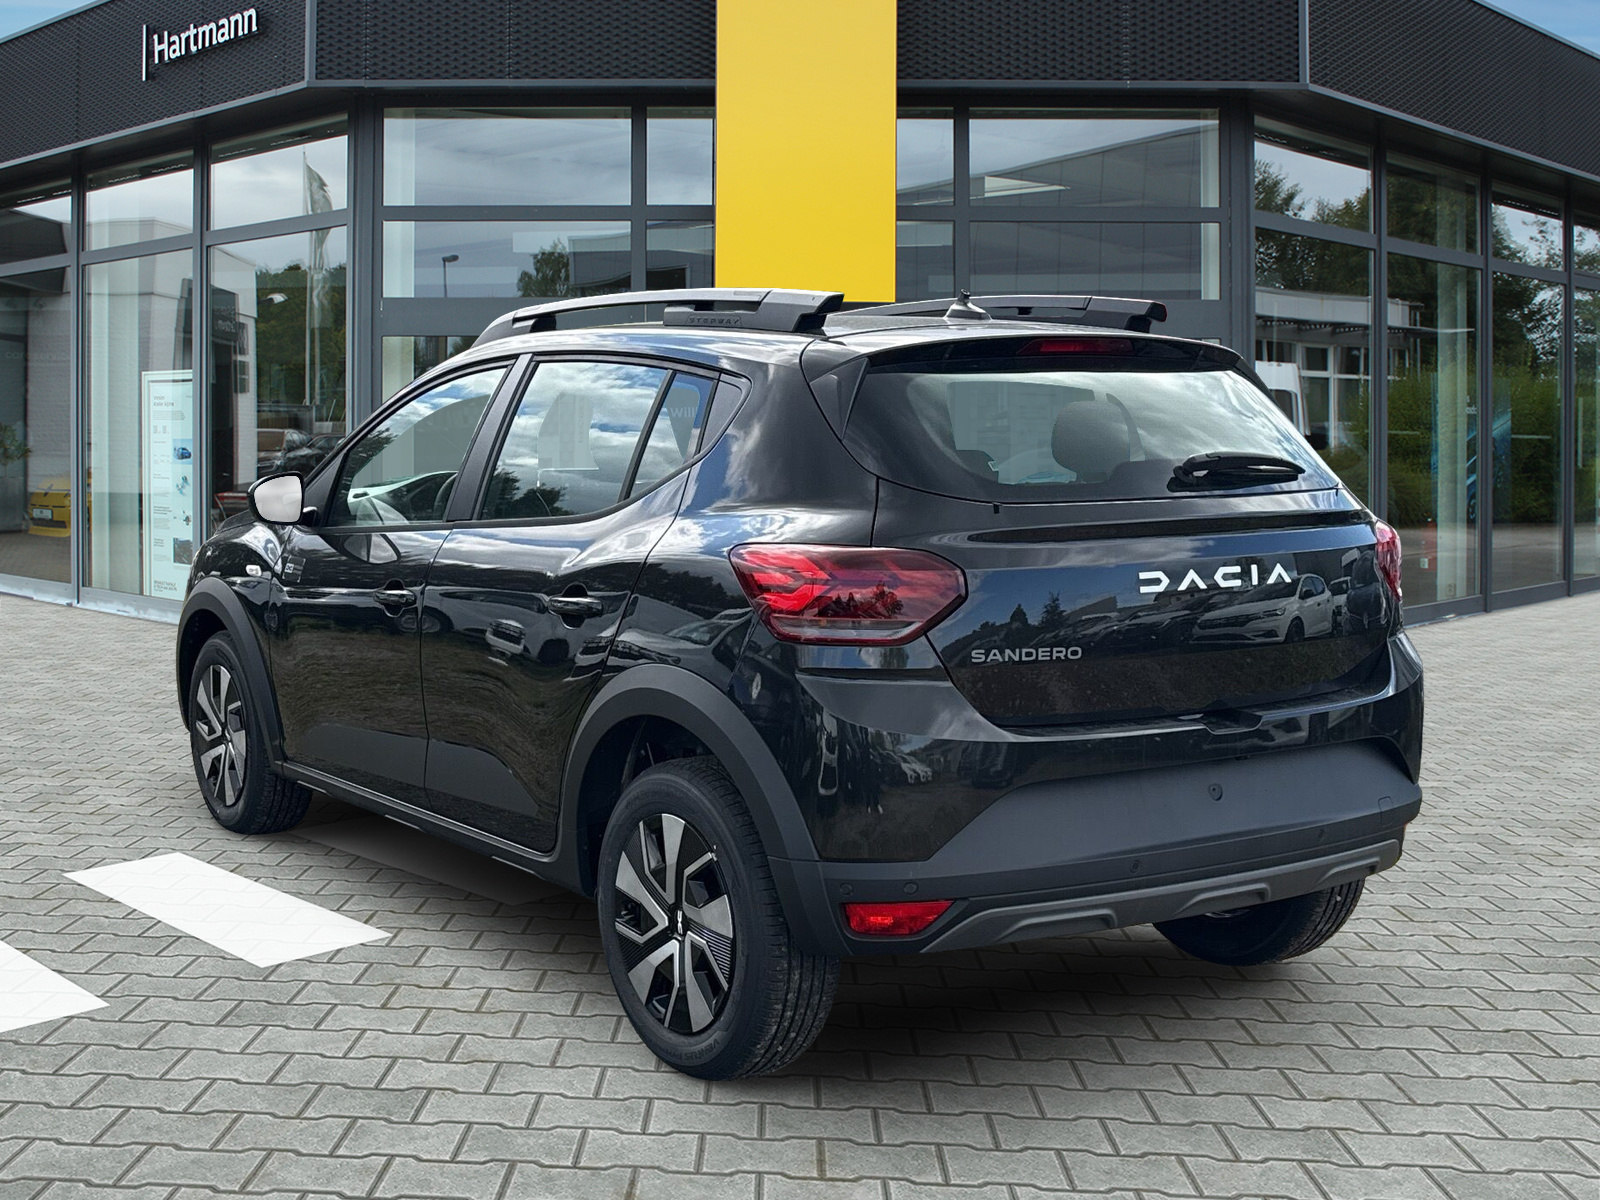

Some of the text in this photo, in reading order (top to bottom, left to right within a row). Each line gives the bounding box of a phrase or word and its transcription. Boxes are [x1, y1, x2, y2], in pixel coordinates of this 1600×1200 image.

[153, 8, 258, 64] Hartmann
[689, 316, 740, 325] STEPWAY
[1138, 562, 1292, 594] DACIA
[971, 646, 1083, 663] SANDERO
